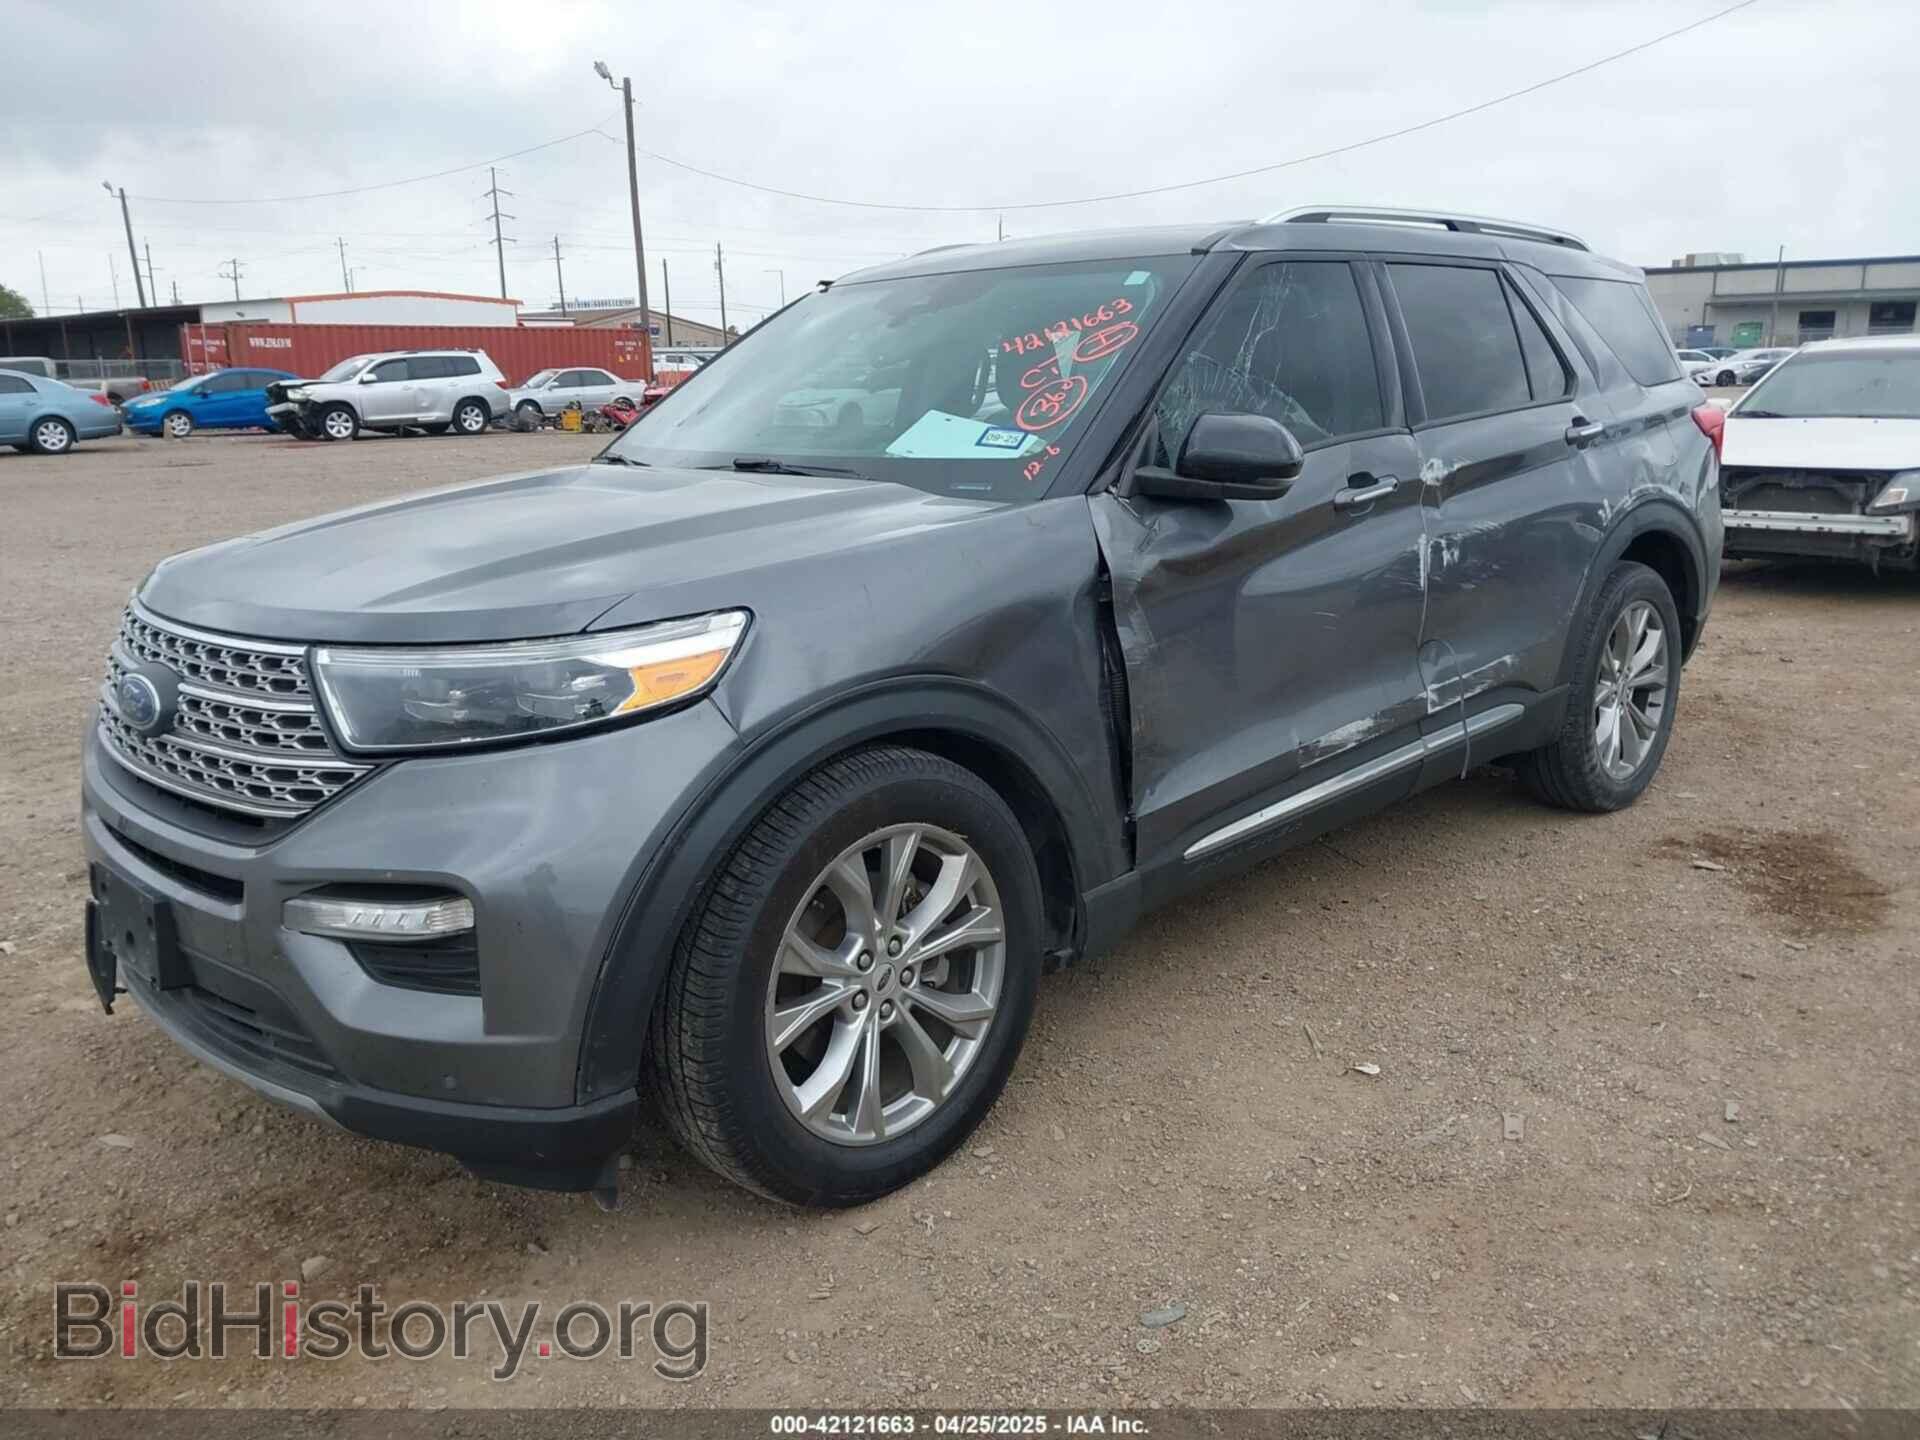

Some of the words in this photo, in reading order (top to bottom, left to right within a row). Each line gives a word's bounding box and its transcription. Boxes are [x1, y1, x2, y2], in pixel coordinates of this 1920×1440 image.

[1002, 298, 1133, 355] 42121663
[986, 432, 1020, 444] 09-25
[1023, 445, 1061, 481] 12-6
